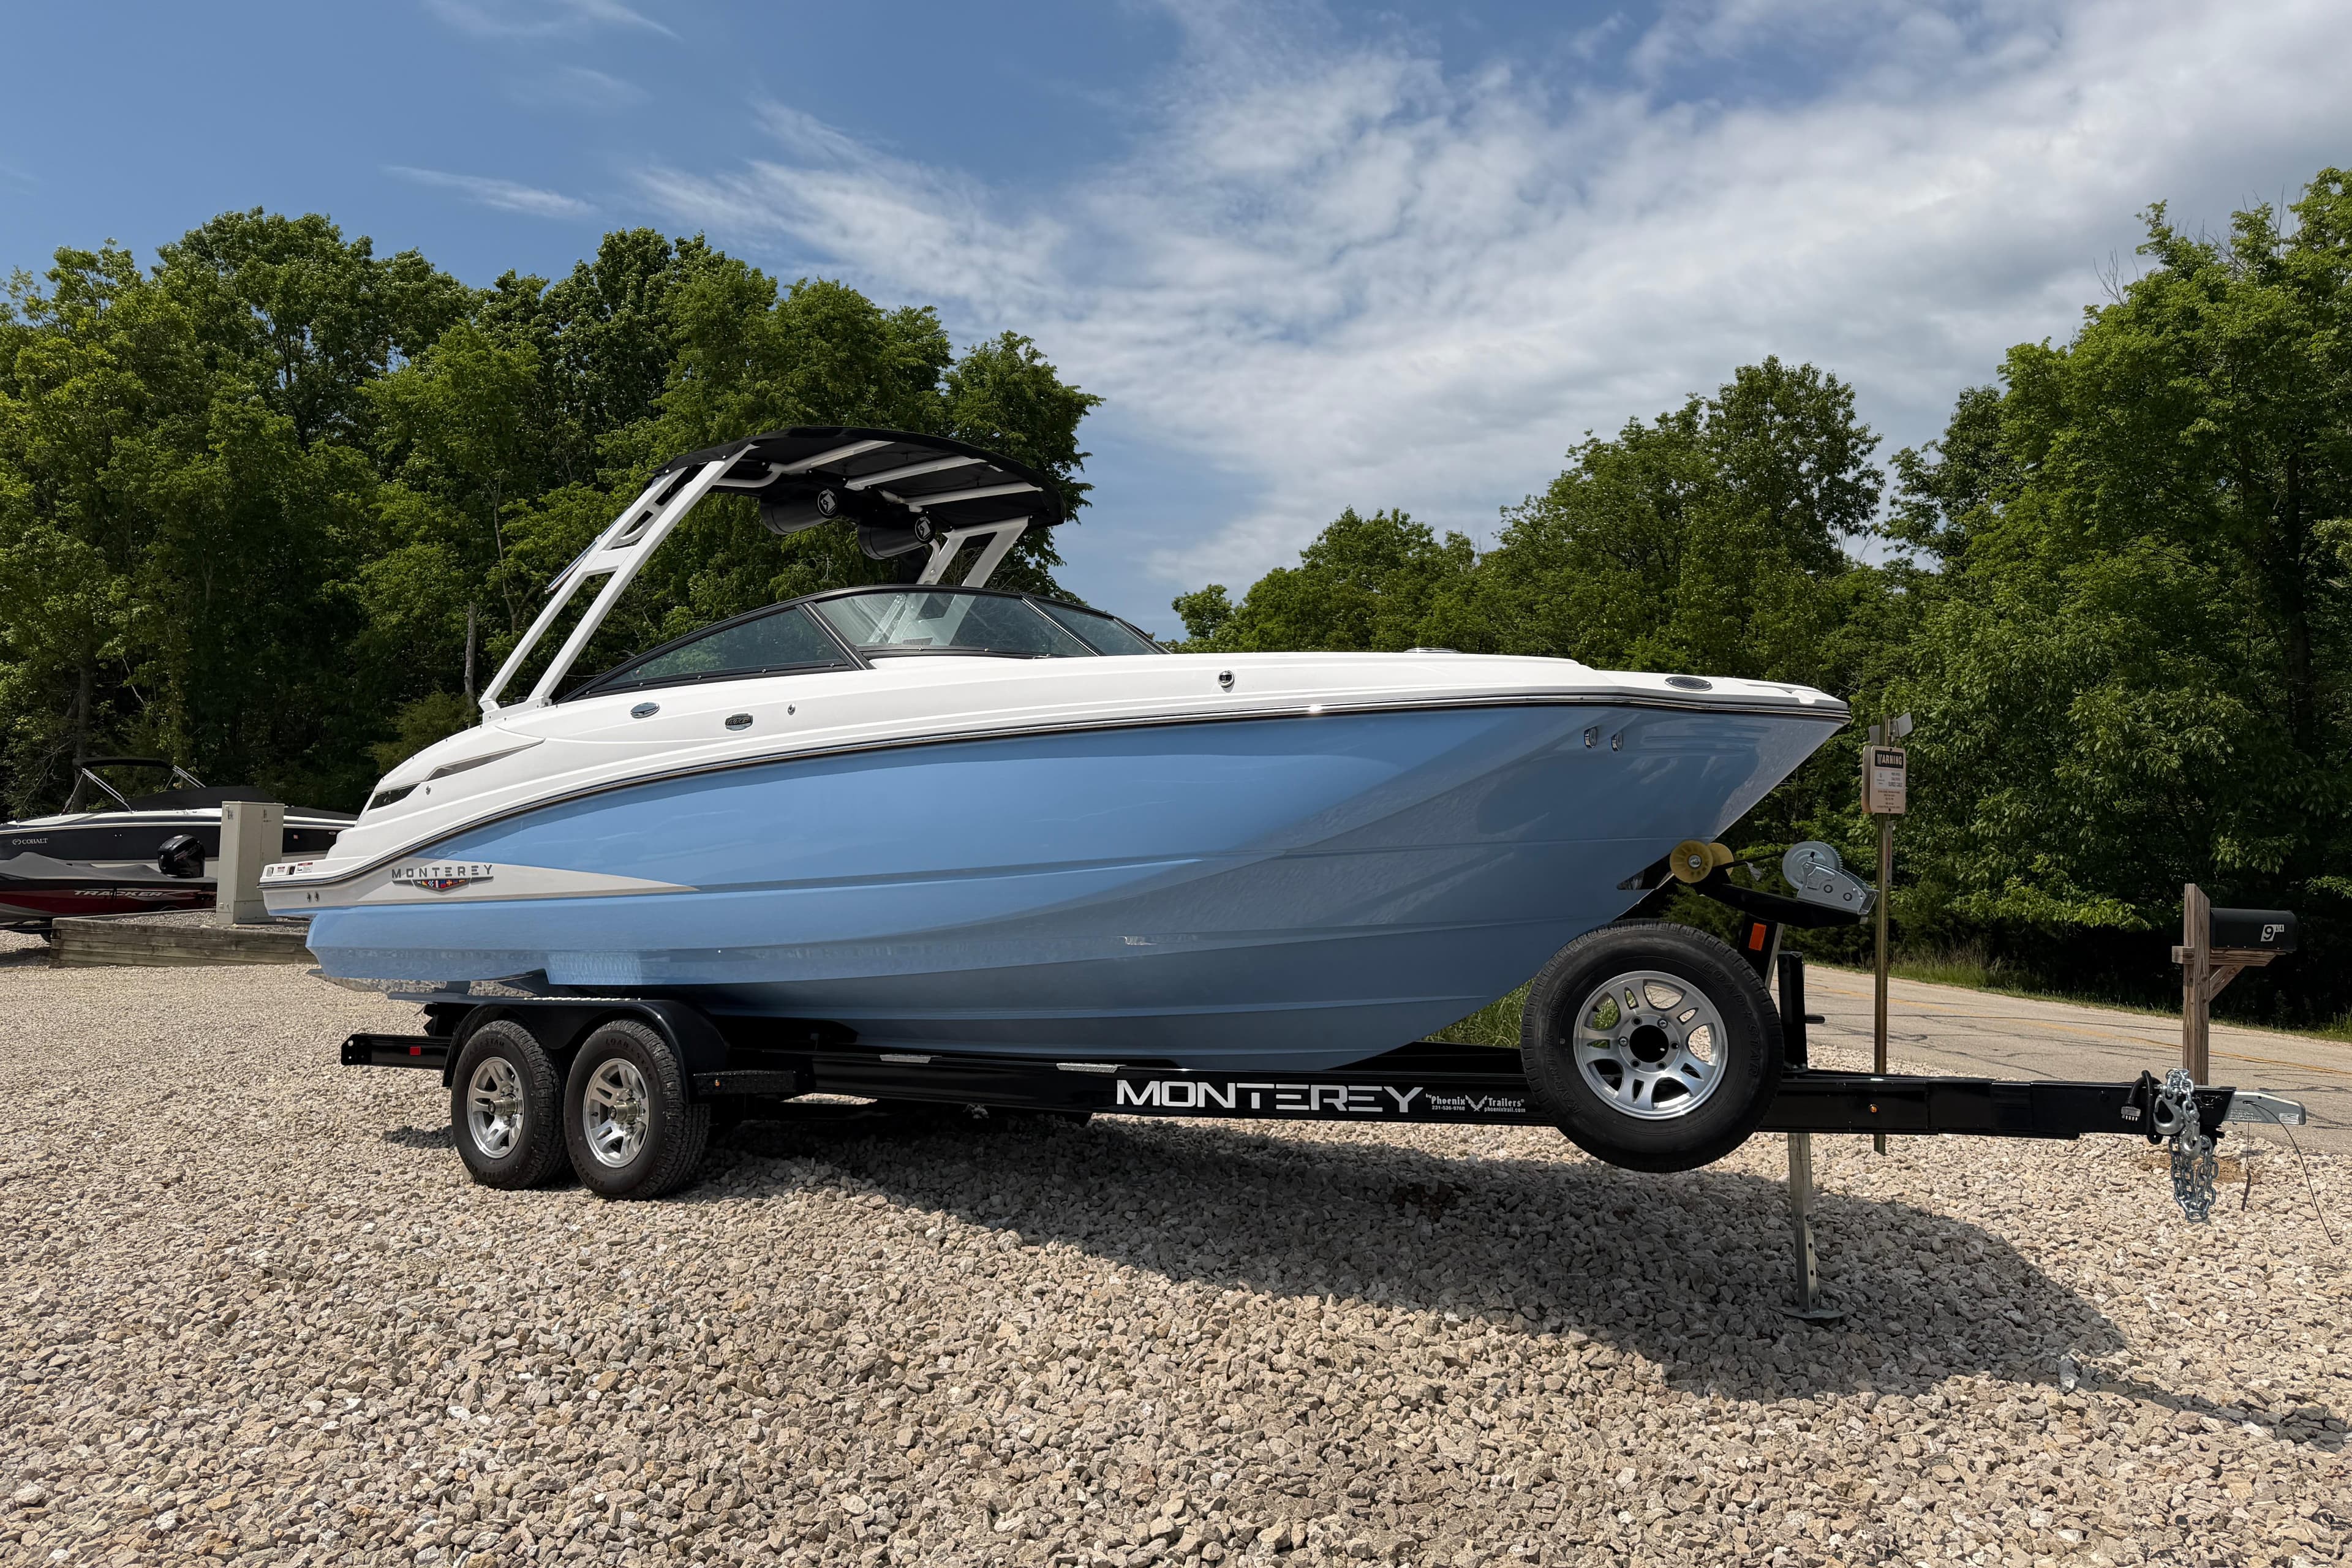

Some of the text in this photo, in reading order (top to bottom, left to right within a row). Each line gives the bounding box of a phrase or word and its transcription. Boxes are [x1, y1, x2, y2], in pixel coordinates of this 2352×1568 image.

[1877, 753, 1902, 766] WARNING
[391, 864, 492, 878] MONTEREY
[1117, 1079, 1423, 1112] MONTEREY
[1431, 1095, 1466, 1105] Phoenix
